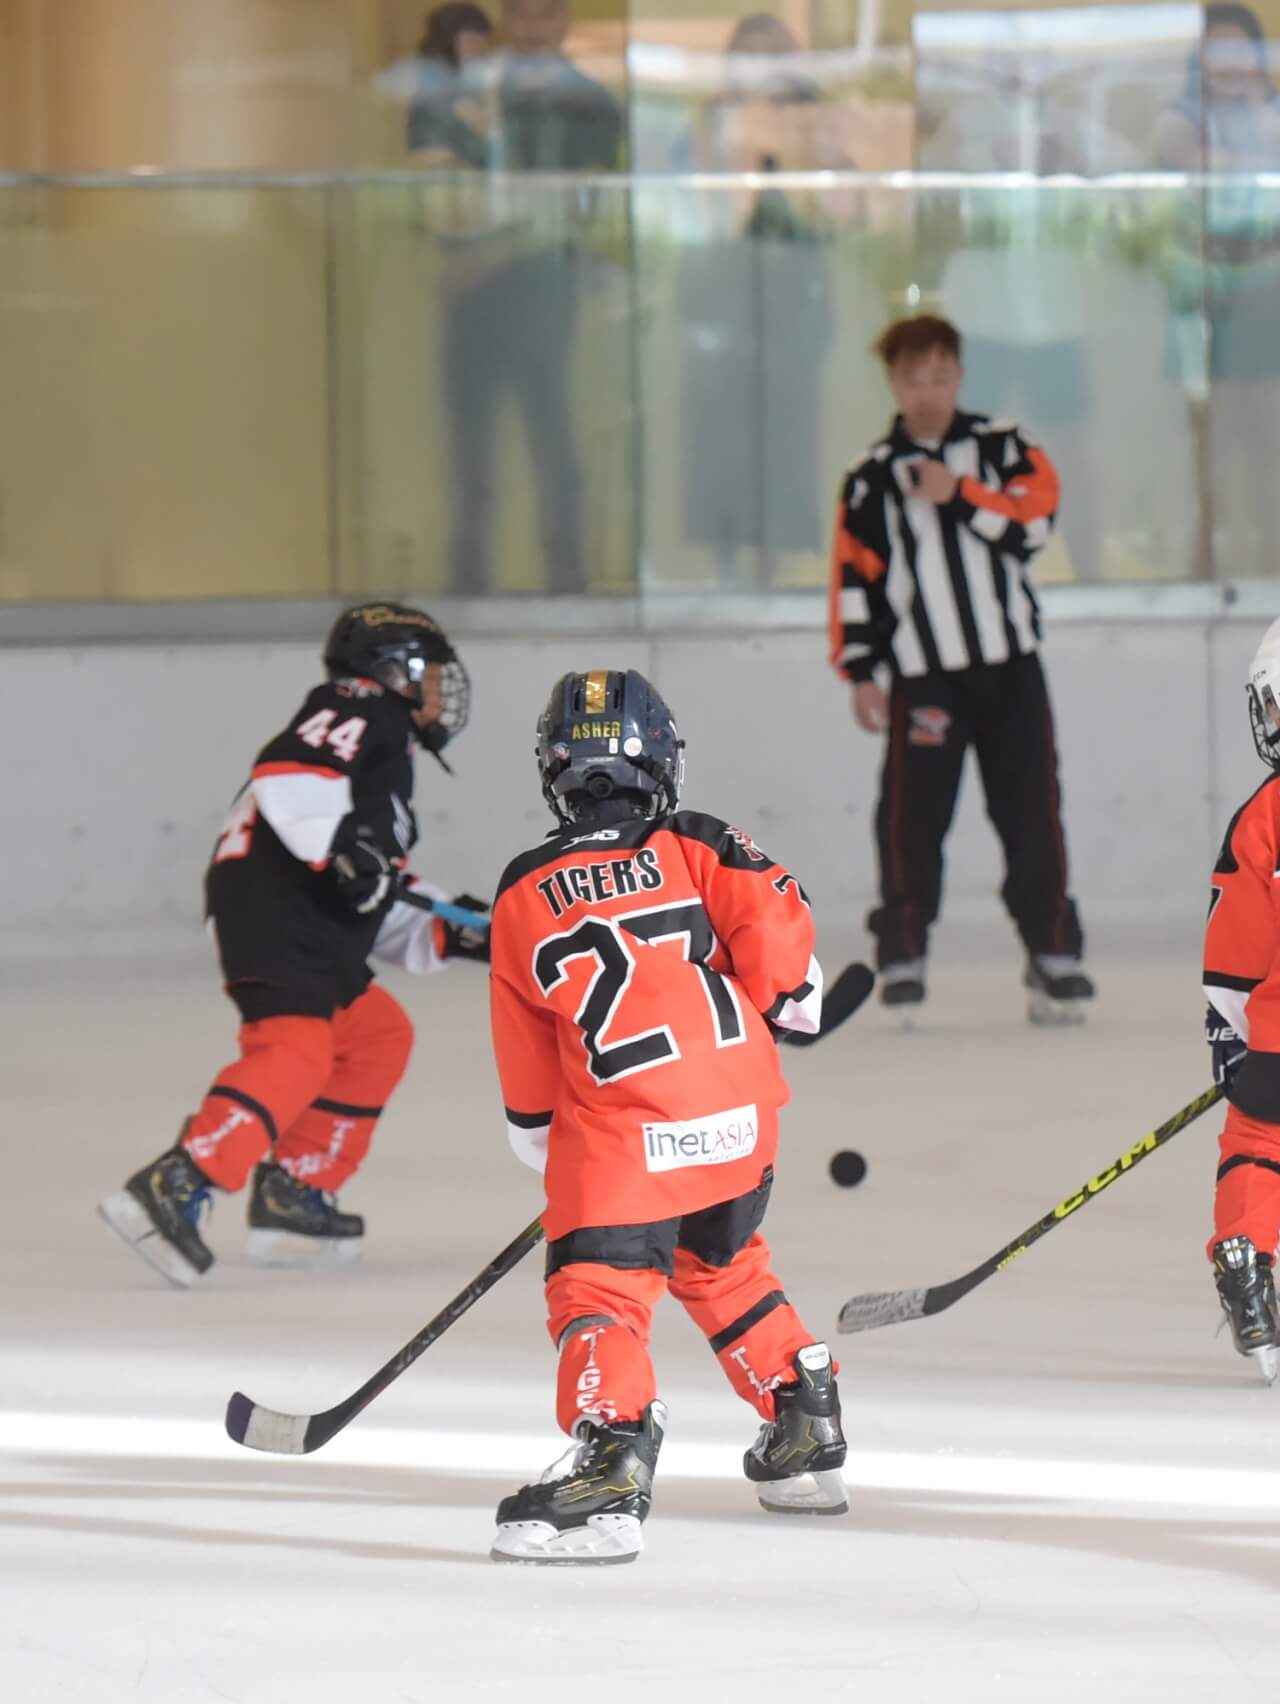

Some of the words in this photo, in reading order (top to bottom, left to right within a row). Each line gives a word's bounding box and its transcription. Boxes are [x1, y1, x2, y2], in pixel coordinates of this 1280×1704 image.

[295, 708, 368, 762] 44
[571, 720, 622, 741] ASHER
[536, 848, 665, 918] TIGERS
[532, 896, 747, 1088] 27
[644, 1120, 755, 1158] inetASIA
[1054, 1131, 1158, 1219] CCM
